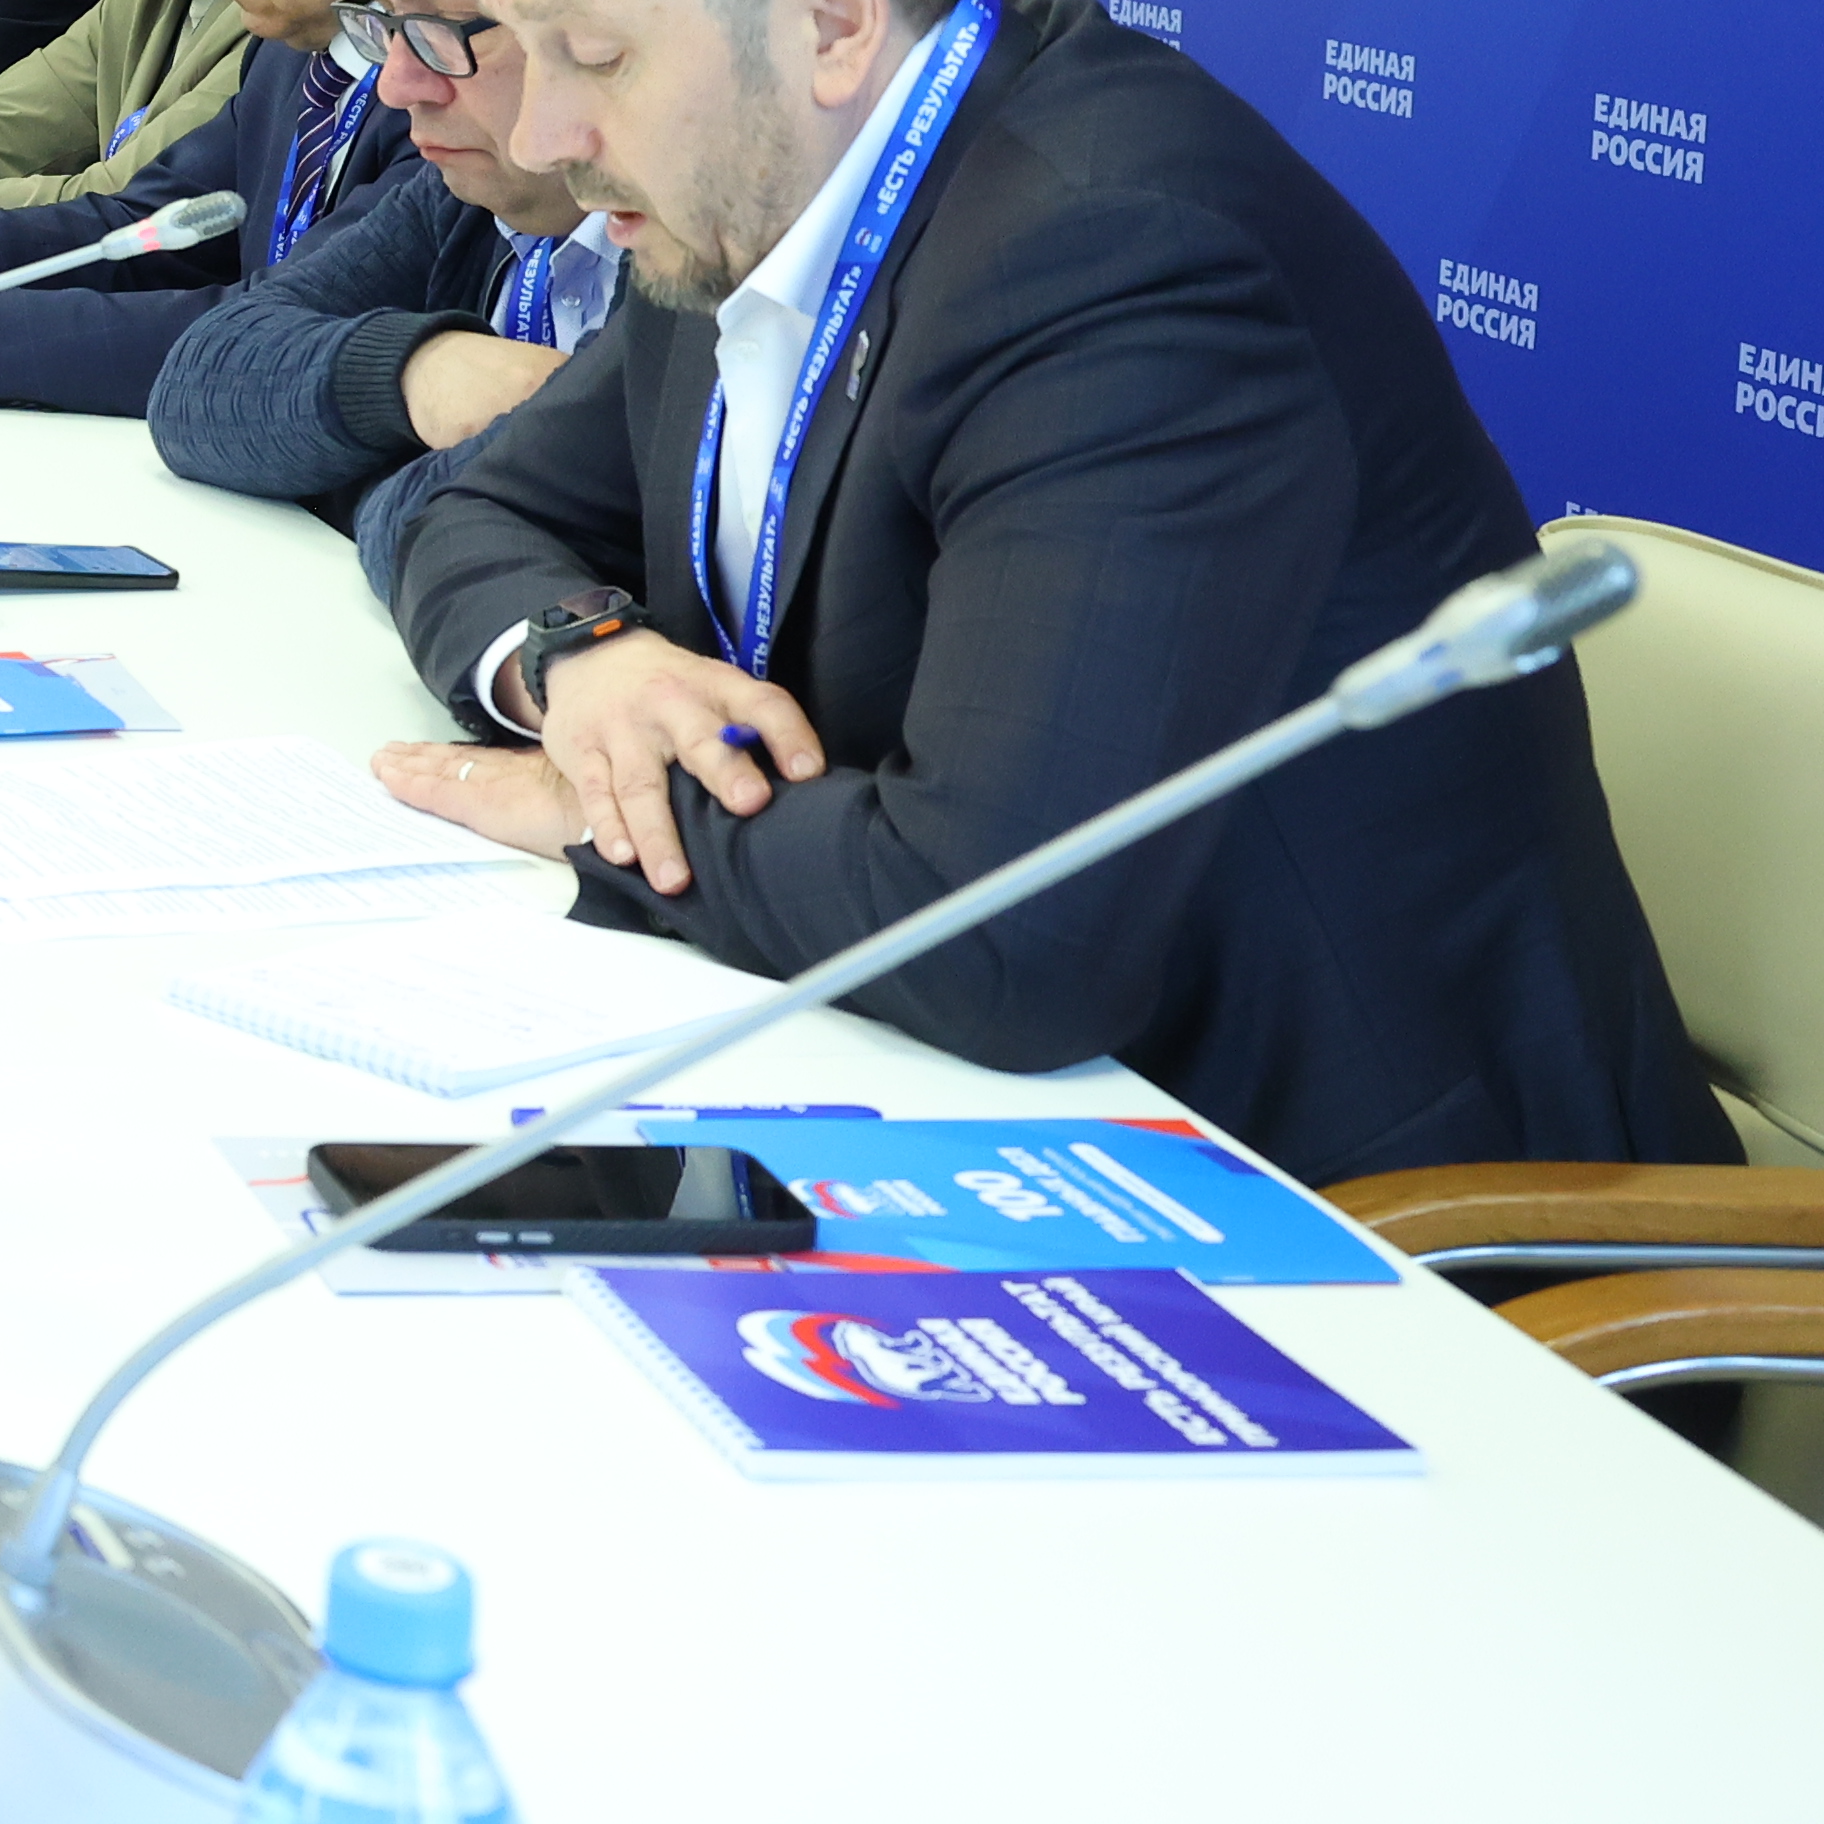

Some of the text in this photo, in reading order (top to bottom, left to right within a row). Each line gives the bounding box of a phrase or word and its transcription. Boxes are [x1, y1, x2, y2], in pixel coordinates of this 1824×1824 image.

[1326, 39, 1415, 82] ЕДИНАЯ
[345, 92, 368, 130] «ЕСТЬ
[877, 22, 981, 215] «ЕСТЬ РЕЗУЛЬТАТ»
[1323, 72, 1412, 118] РОССИЯ
[1594, 93, 1706, 144] ЕДИНАЯ
[1592, 130, 1704, 184] РОССИЯ
[1439, 259, 1538, 312] ЕДИНАЯ
[1437, 293, 1535, 350] РОССИЯ
[783, 265, 862, 461] «ЕСТЬ РЕЗУЛЬТАТ»
[1738, 342, 1824, 396] ЕДИН
[755, 513, 777, 636] РЕЗУЛЬТАТ»
[954, 1169, 1065, 1222] 100
[1143, 1388, 1229, 1447] ЕСТЬ
